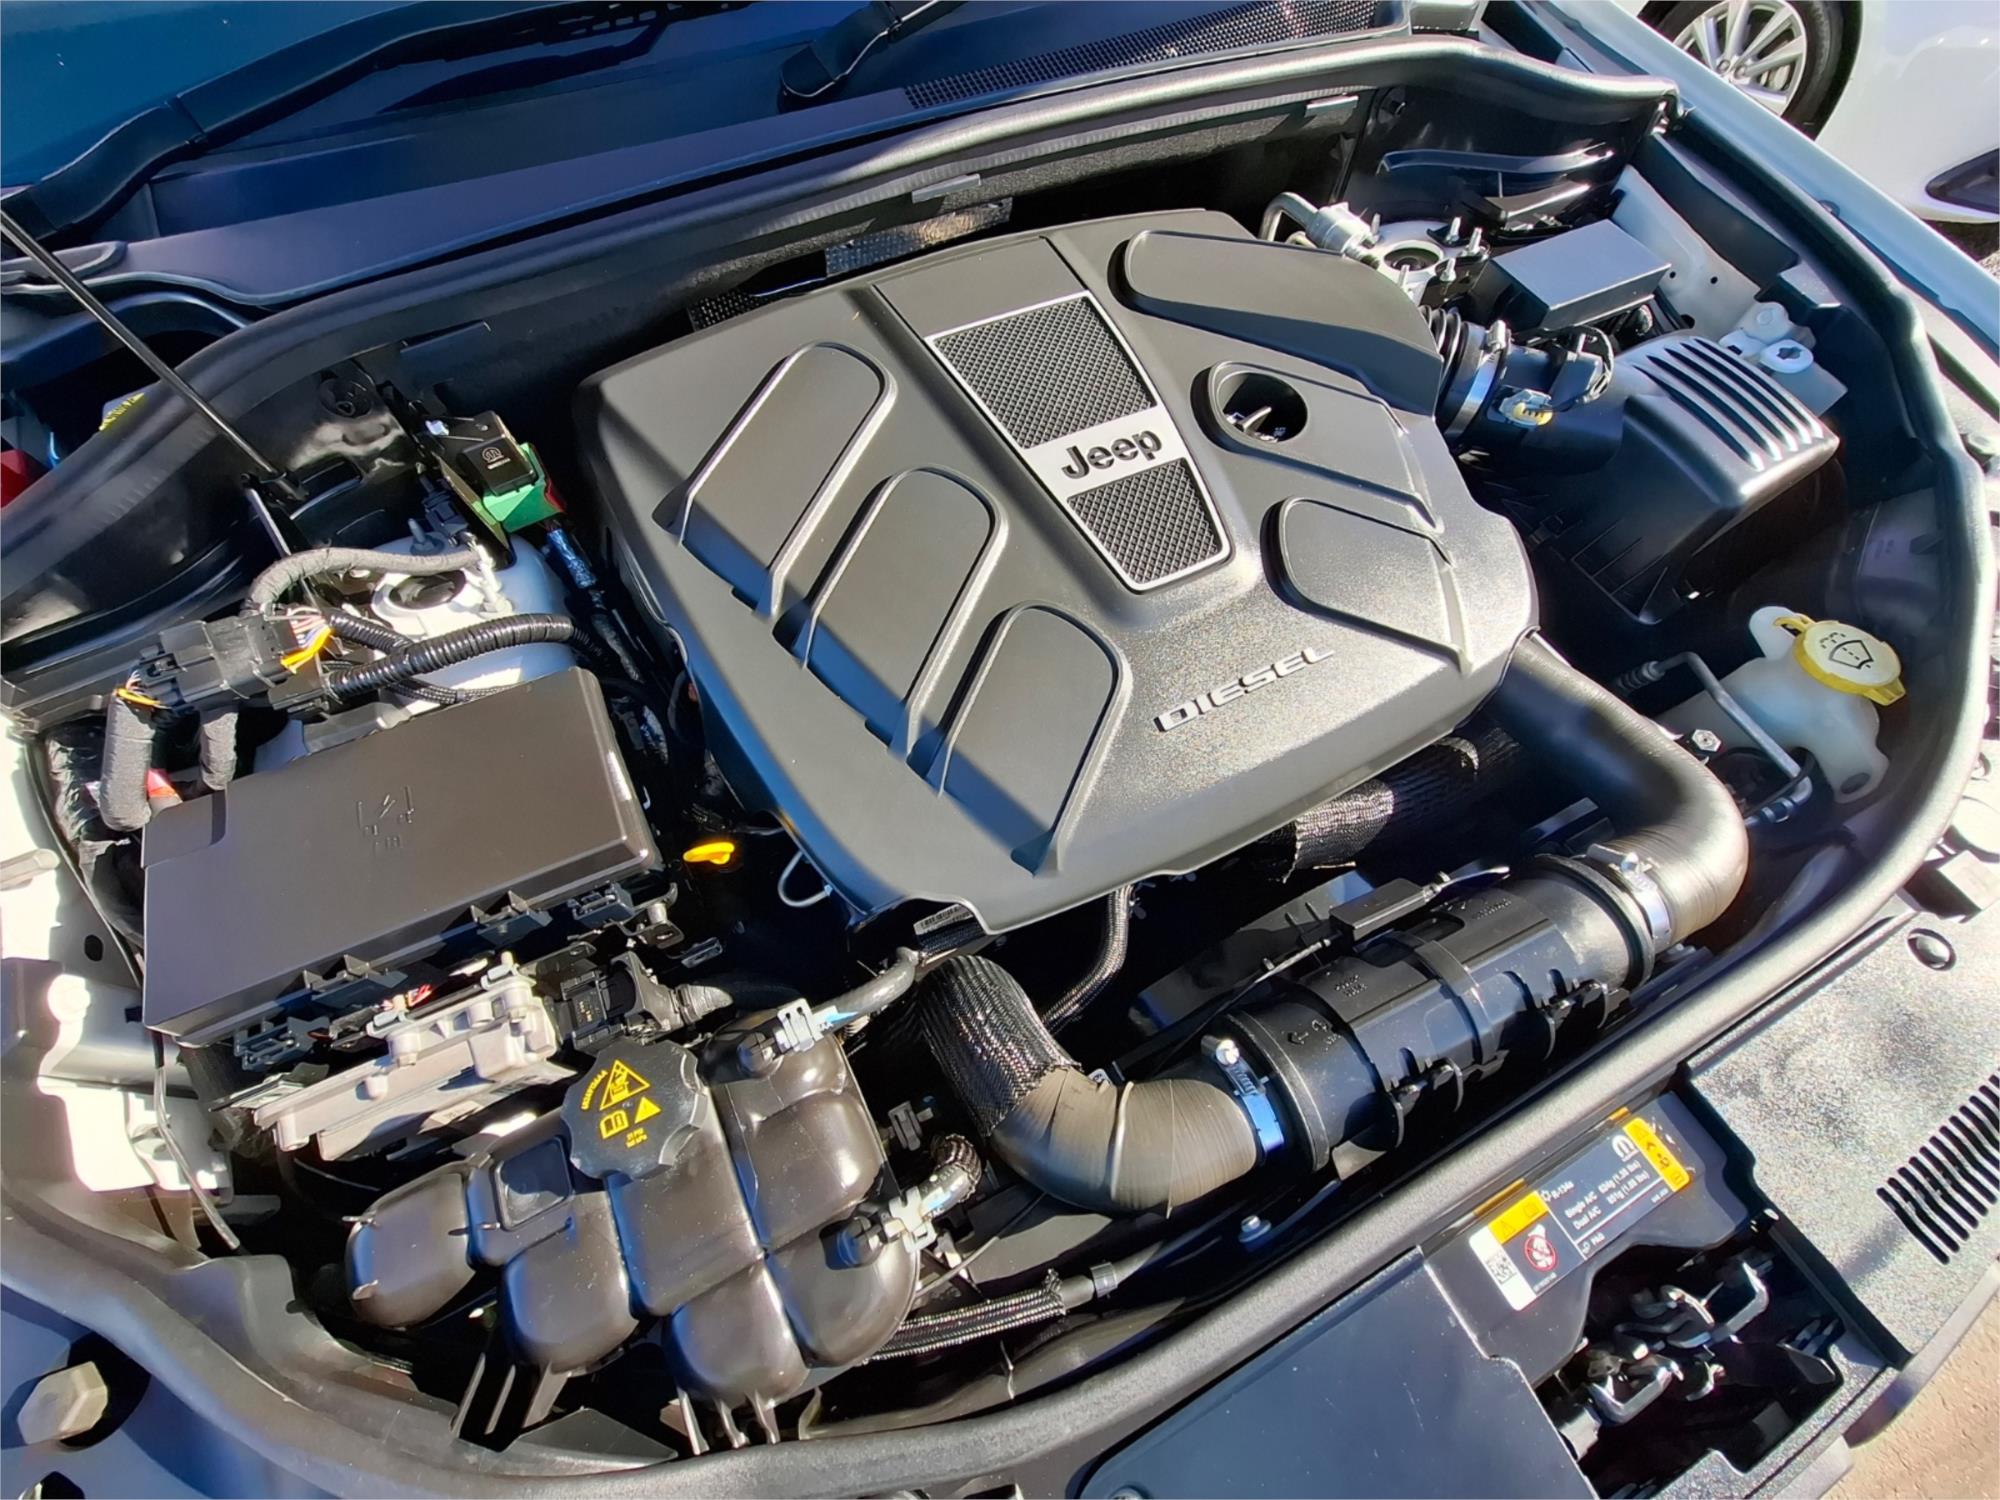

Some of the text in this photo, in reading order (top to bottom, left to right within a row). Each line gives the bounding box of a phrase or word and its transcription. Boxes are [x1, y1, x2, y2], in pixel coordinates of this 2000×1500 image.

[1062, 431, 1162, 479] Jeep
[1153, 647, 1335, 733] DIESEL
[1551, 1181, 1574, 1199] R-134a
[1564, 1200, 1586, 1218] Single
[1584, 1190, 1598, 1205] A/C
[1573, 1213, 1590, 1230] Dual
[1587, 1205, 1602, 1219] A/C
